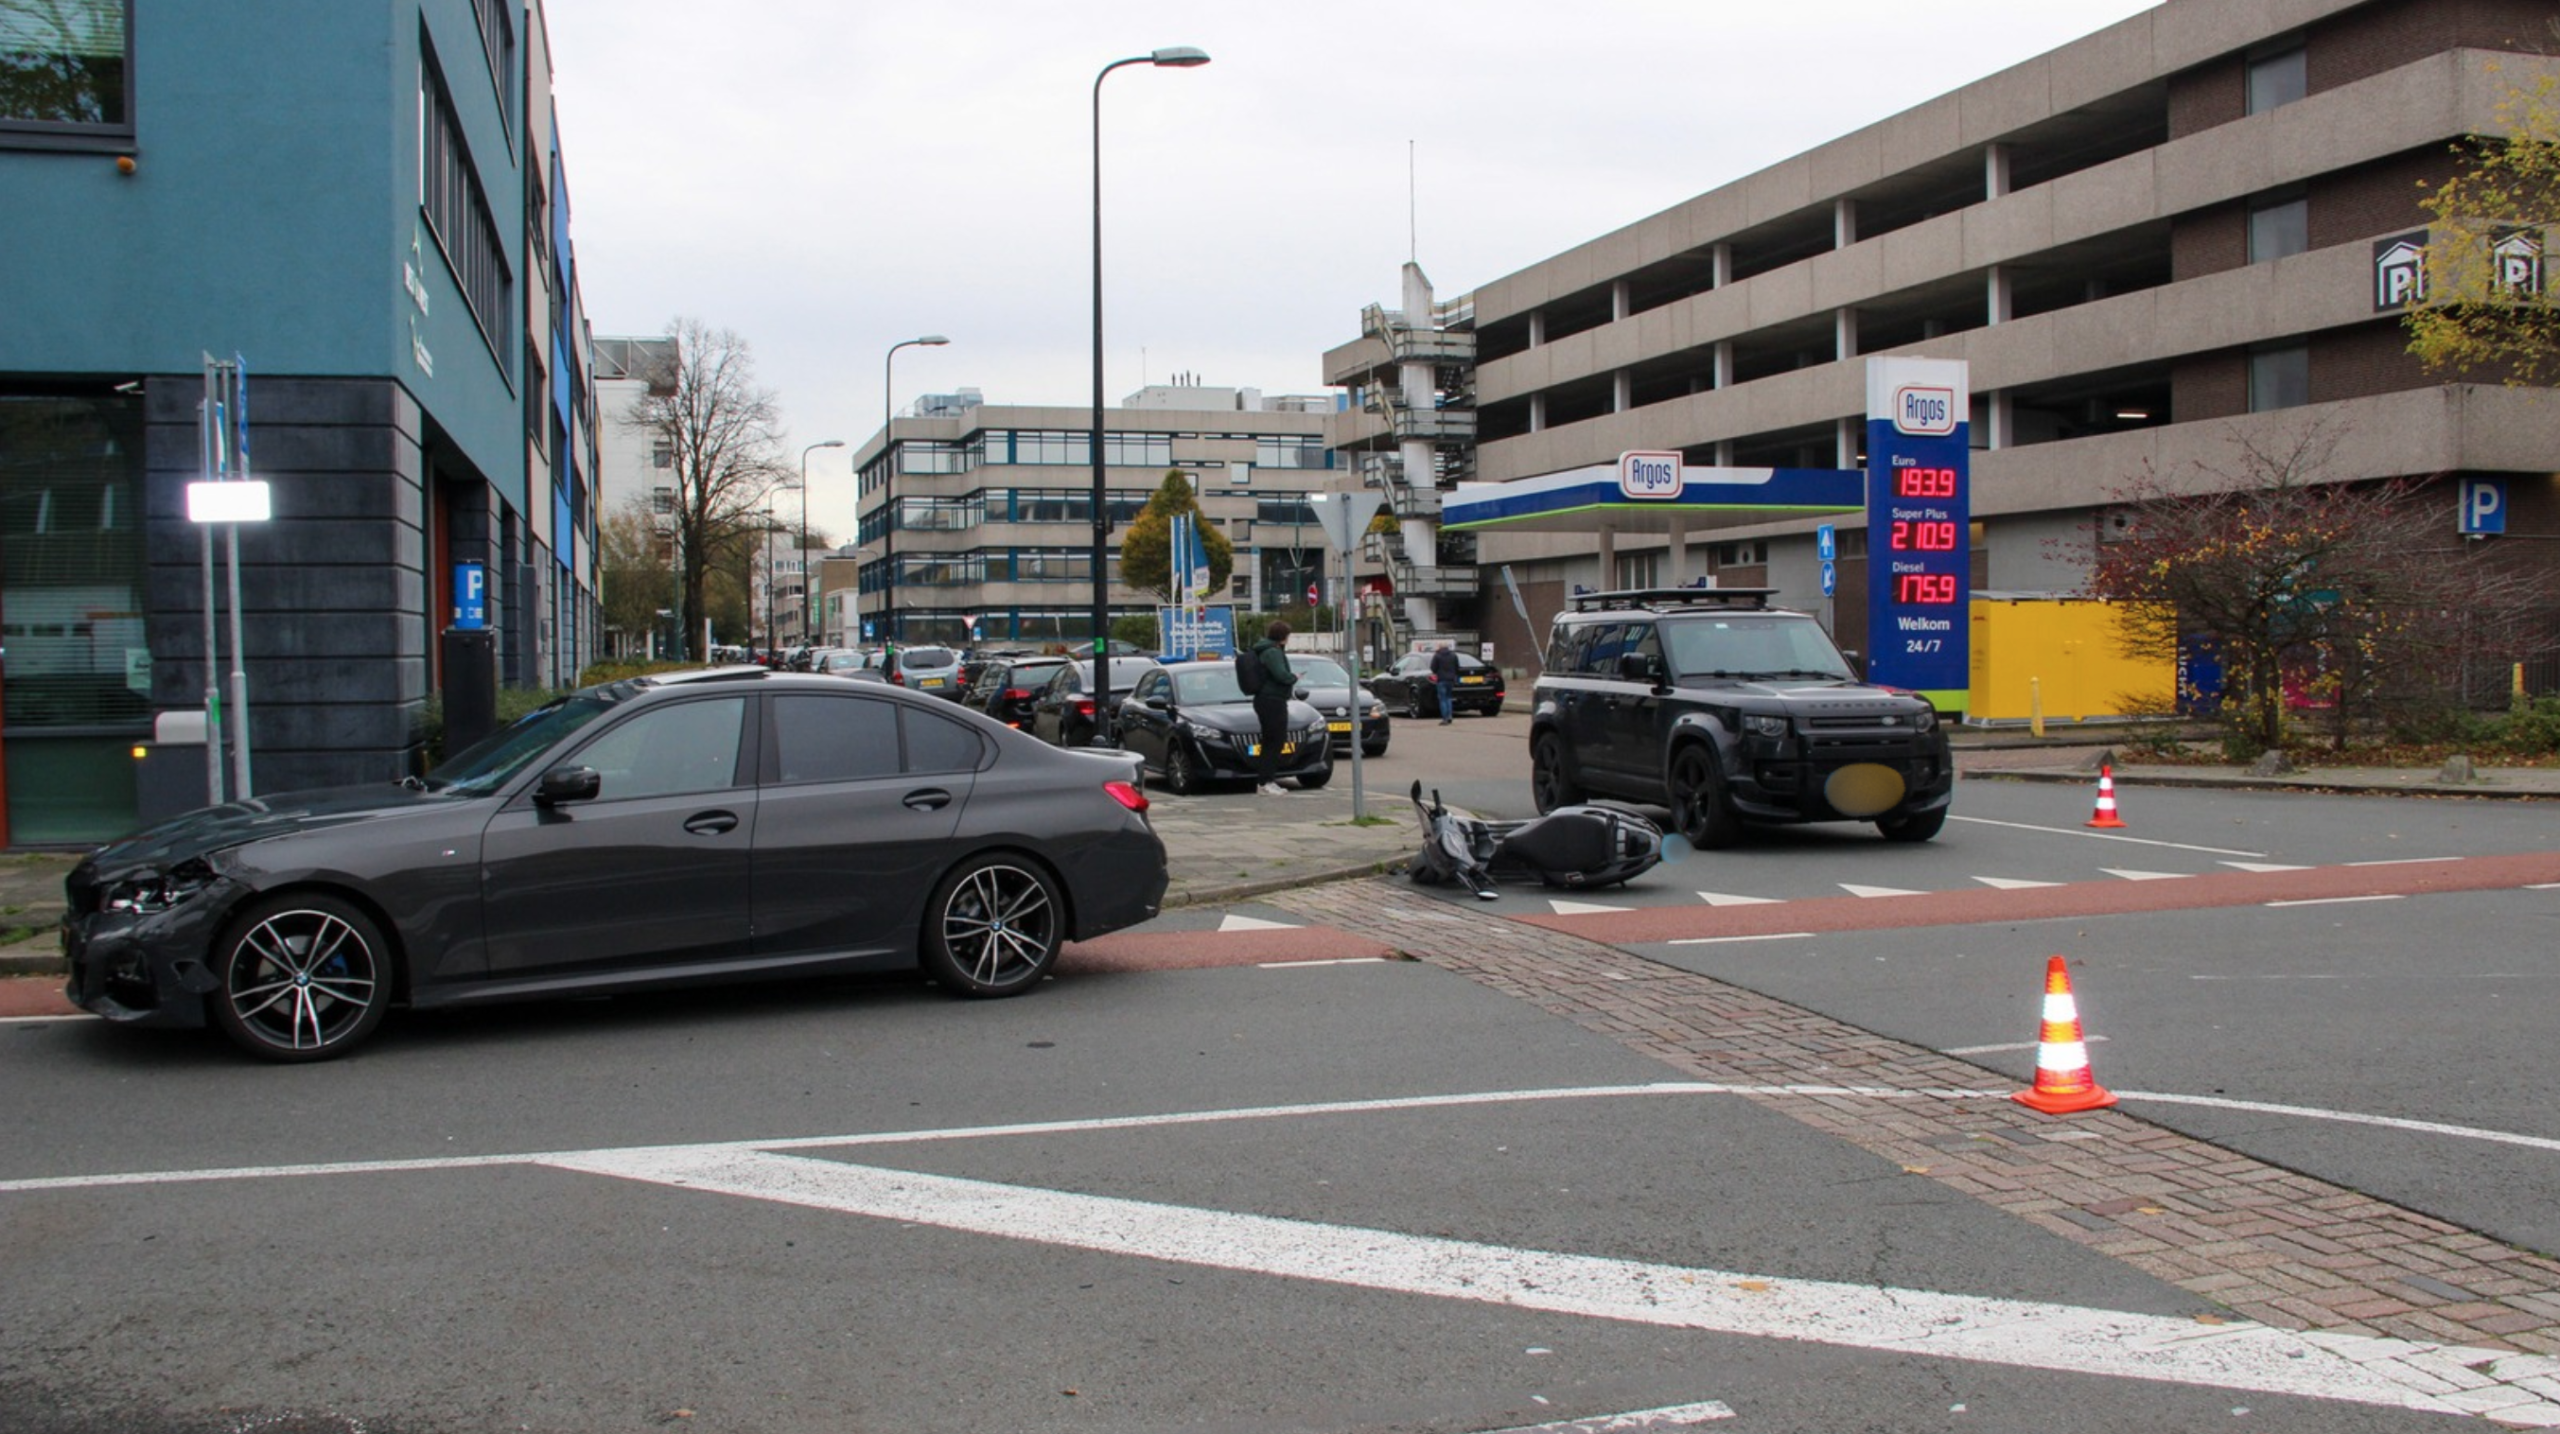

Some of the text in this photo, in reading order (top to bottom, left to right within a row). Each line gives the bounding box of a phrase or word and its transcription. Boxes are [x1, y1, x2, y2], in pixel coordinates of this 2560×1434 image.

[1906, 393, 1945, 426] Argos
[1632, 458, 1671, 489] Argos
[1891, 455, 1917, 466] Euro
[1901, 468, 1955, 497] 193.9
[1892, 508, 1948, 520] Super Plus
[2472, 483, 2499, 528] P
[1892, 562, 1924, 573] Diesel
[467, 570, 483, 600] P
[1901, 575, 1955, 603] 175.9
[1897, 617, 1950, 631] Welkom
[1906, 640, 1942, 653] 24/7
[2178, 646, 2188, 698] LUCHT
